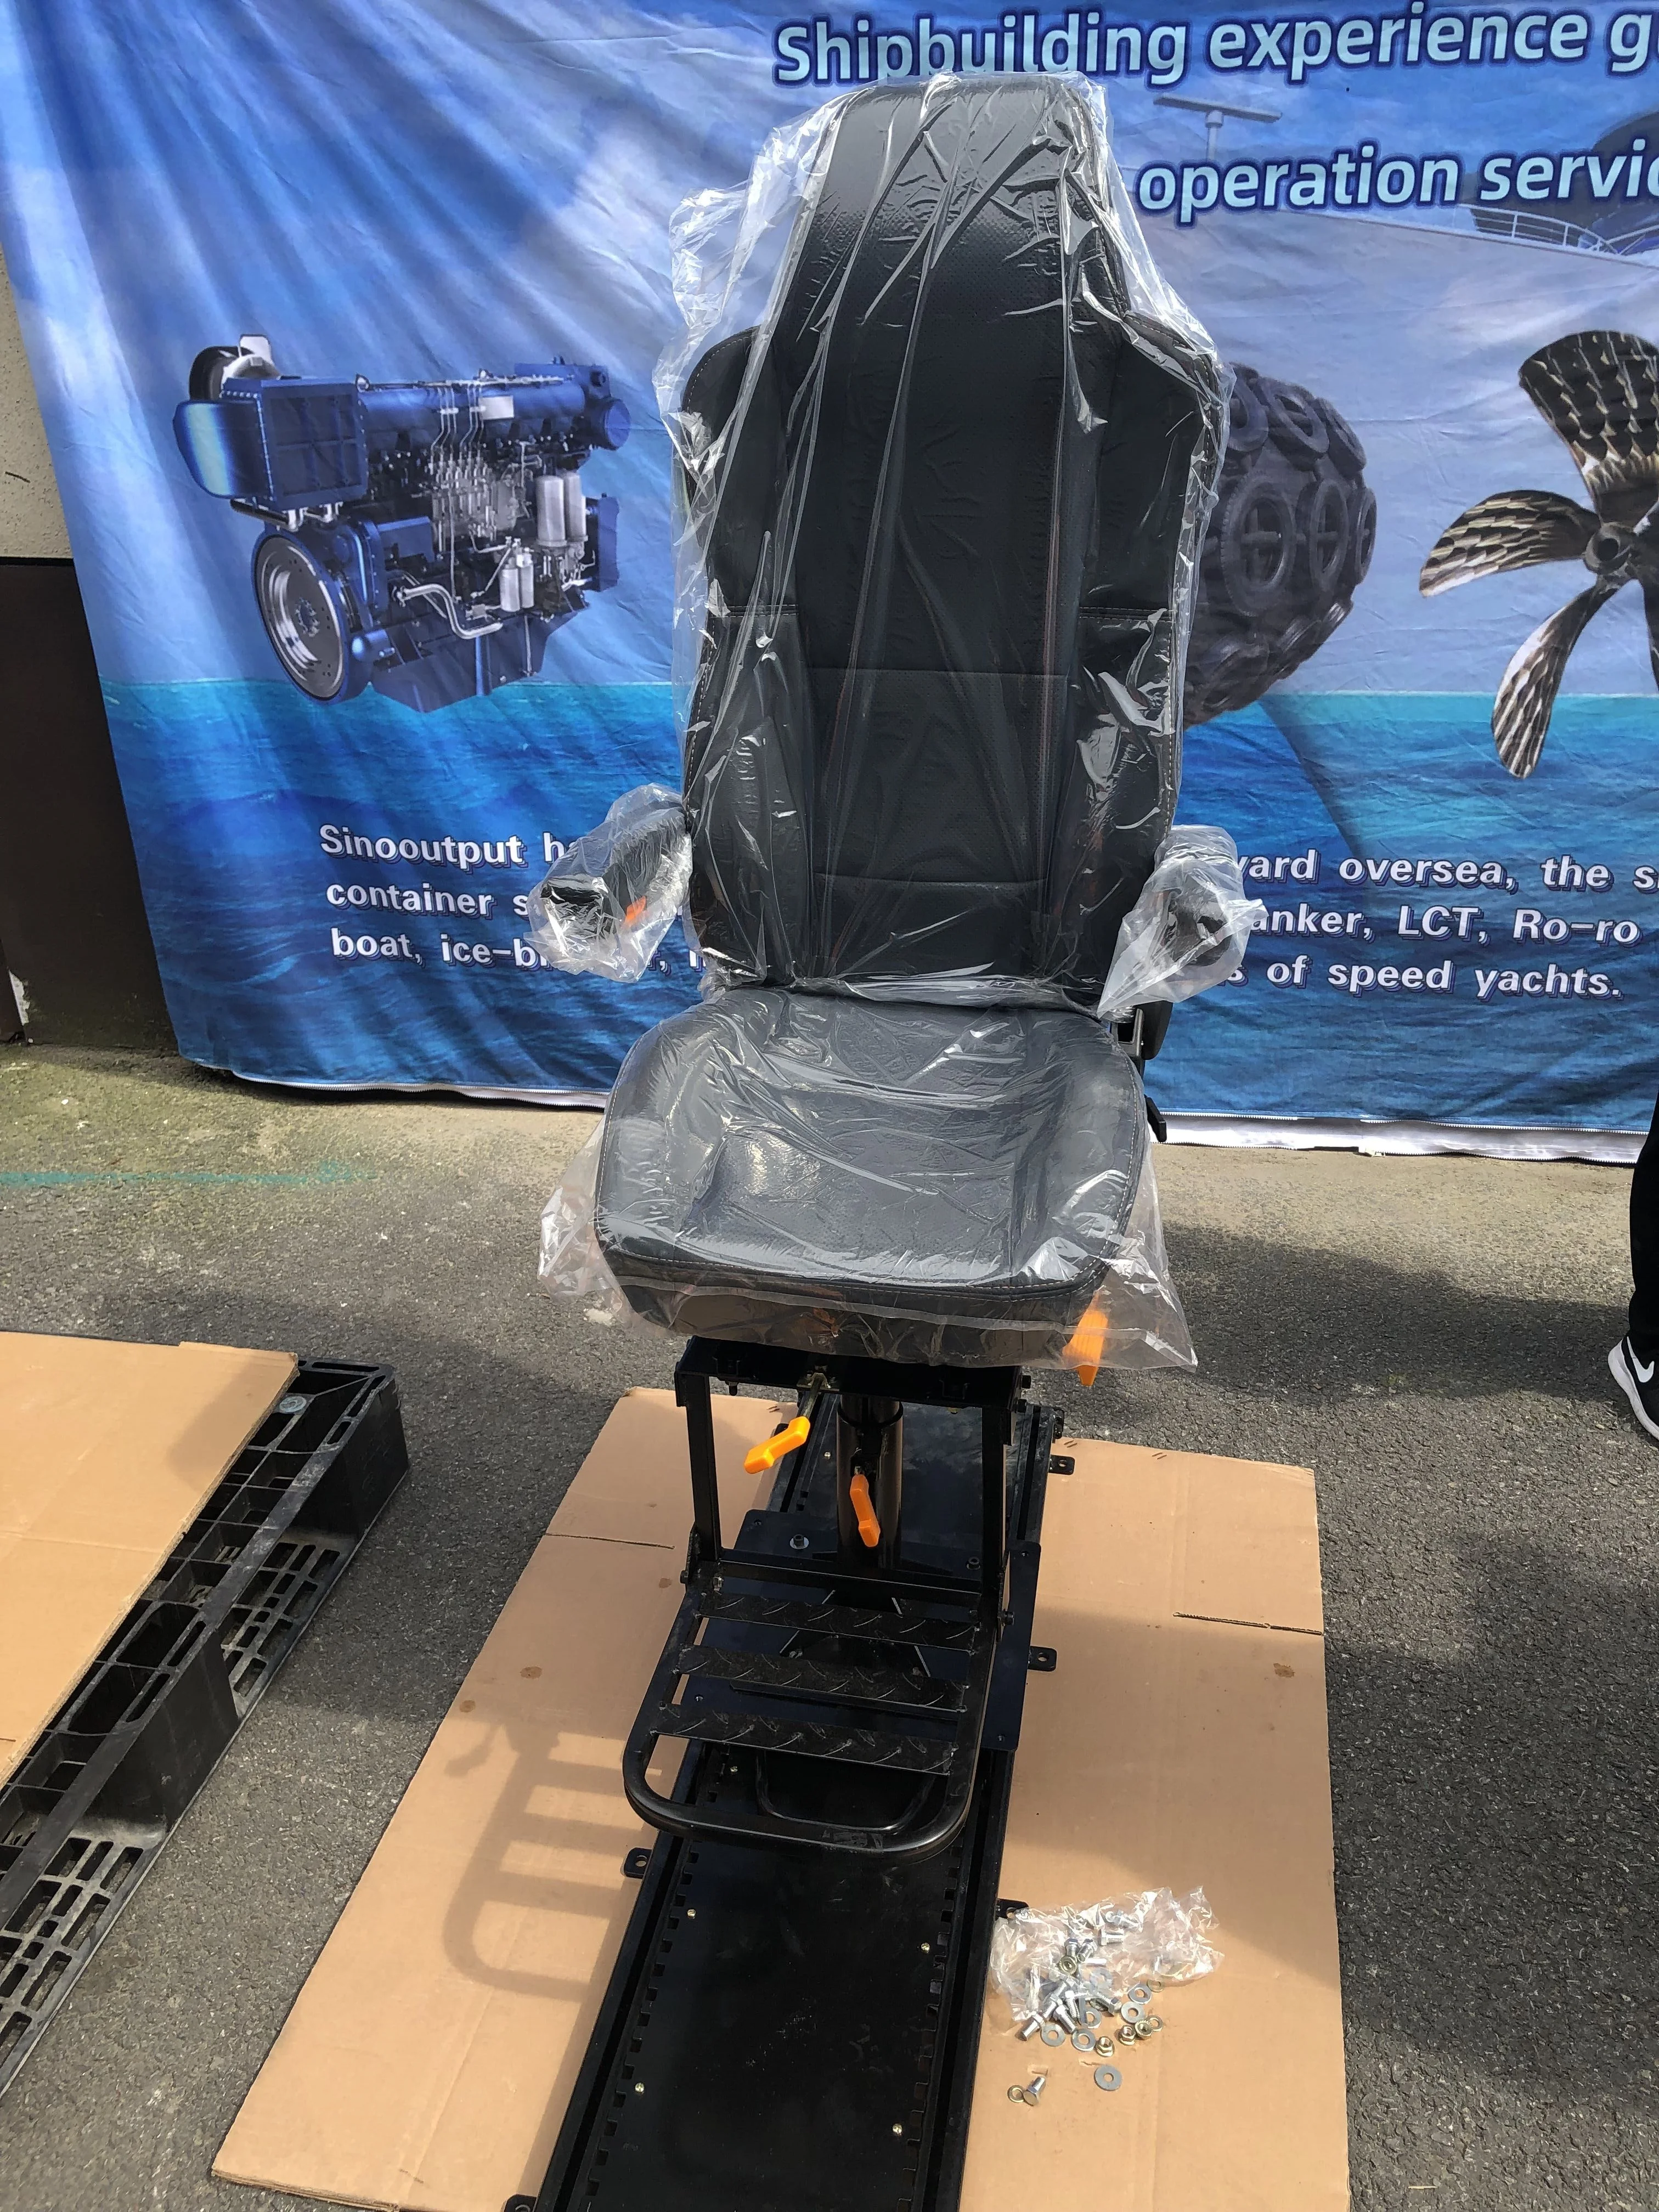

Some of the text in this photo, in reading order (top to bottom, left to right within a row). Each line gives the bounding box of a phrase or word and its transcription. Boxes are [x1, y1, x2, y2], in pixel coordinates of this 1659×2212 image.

[775, 1, 1659, 86] Shipbuilding experience g
[1138, 145, 1458, 224] operation
[318, 824, 524, 870] Sinooutput
[1339, 857, 1517, 891] oversea,
[1541, 855, 1611, 888] the
[1633, 865, 1659, 890] s
[326, 882, 494, 916] container
[1398, 905, 1488, 944] LCT,
[1513, 909, 1639, 945] Ro-ro
[330, 928, 424, 966] boat,
[1266, 955, 1308, 985] of
[1328, 961, 1454, 995] speed
[1475, 964, 1622, 1000] yachts.
